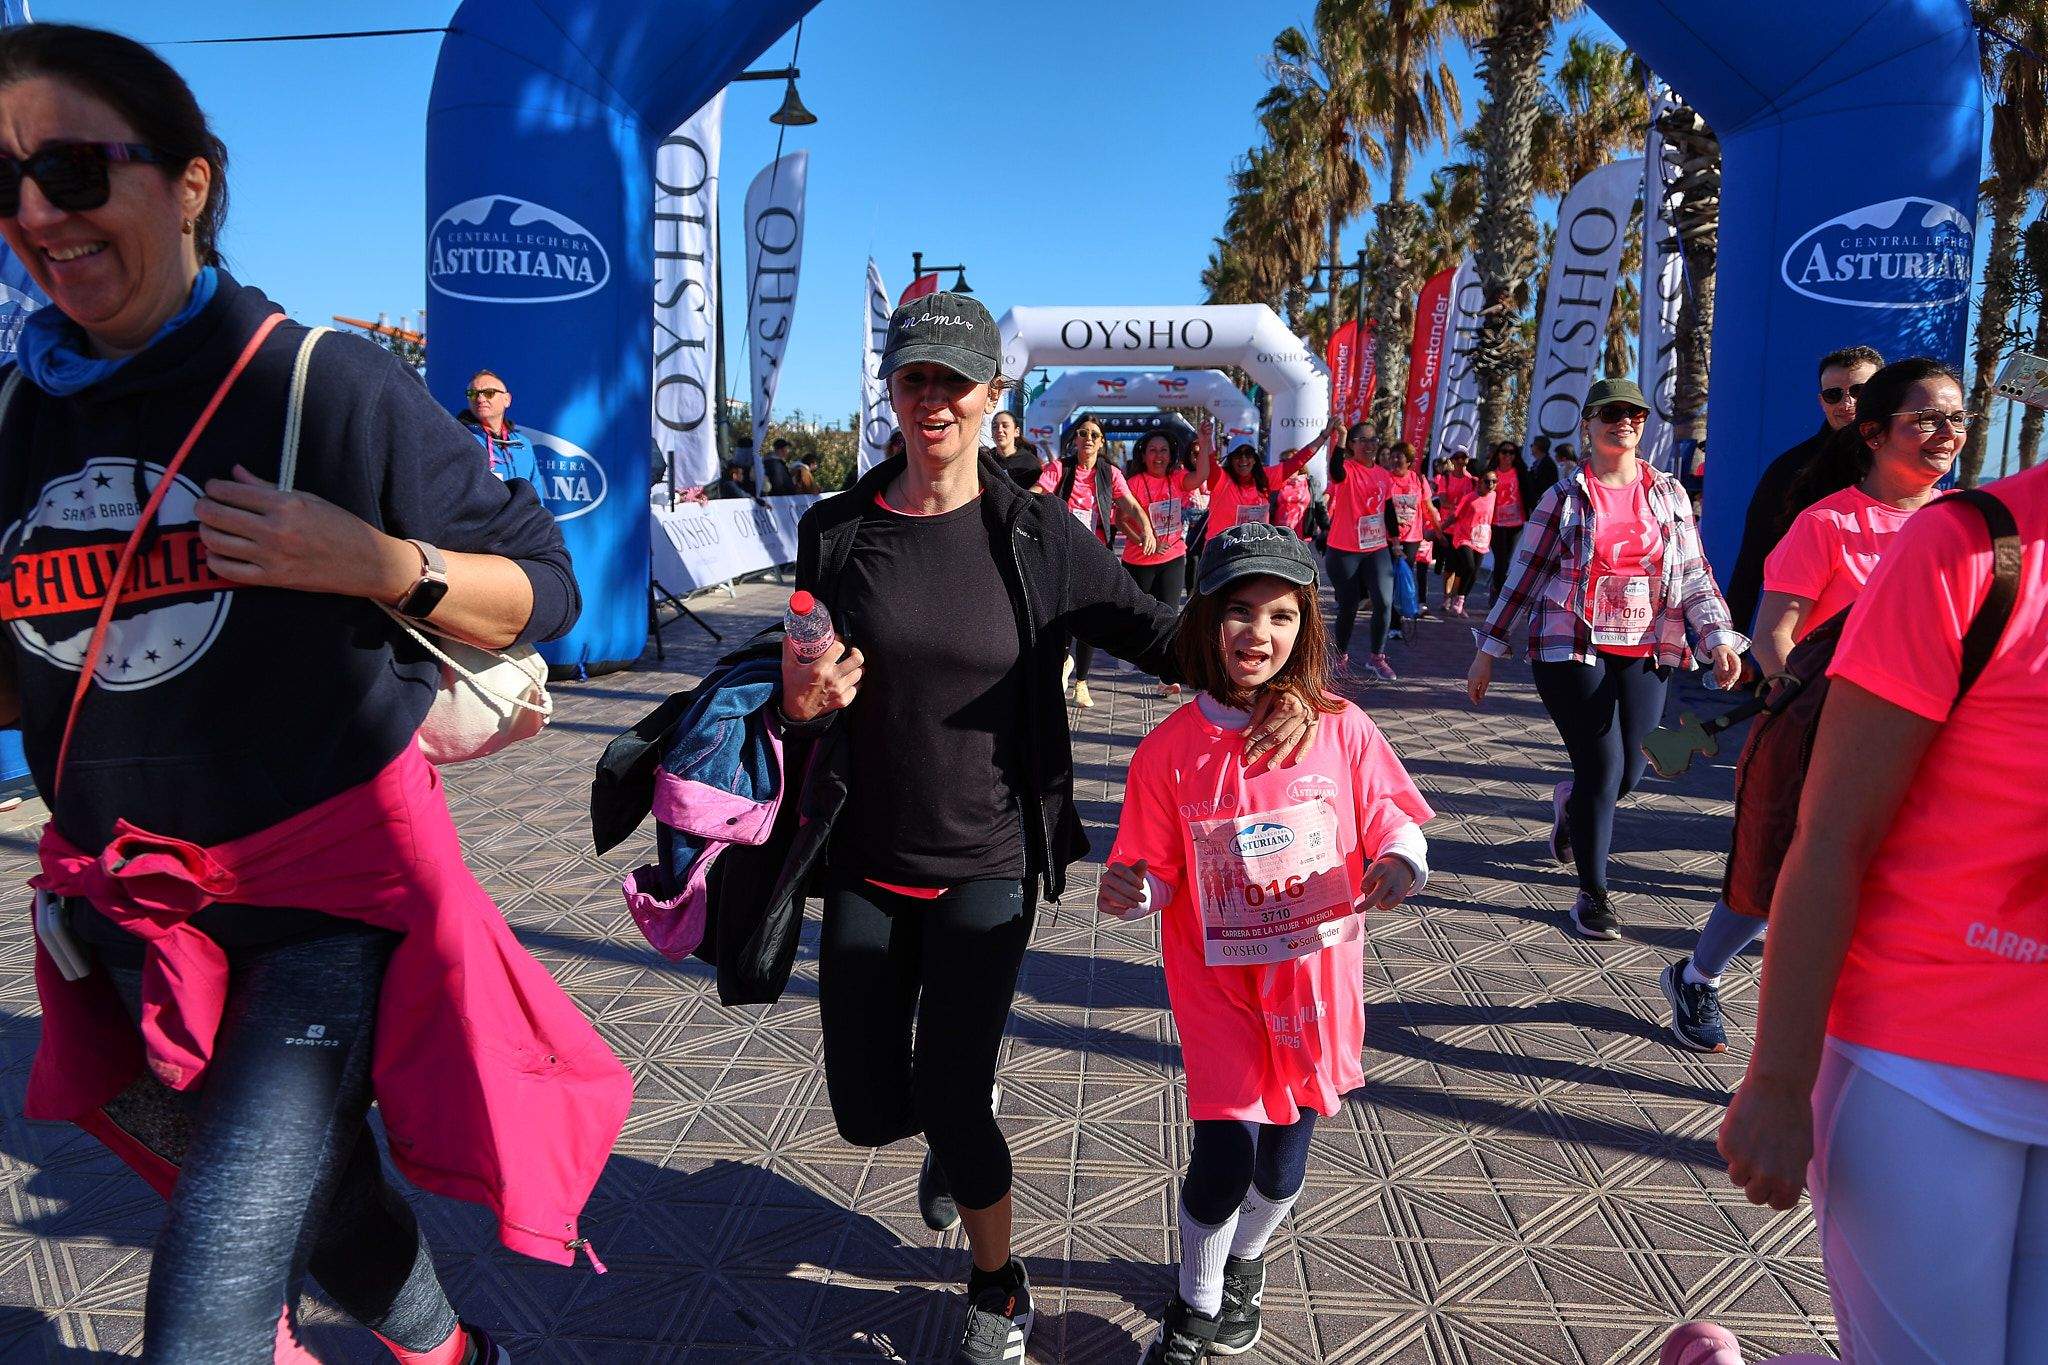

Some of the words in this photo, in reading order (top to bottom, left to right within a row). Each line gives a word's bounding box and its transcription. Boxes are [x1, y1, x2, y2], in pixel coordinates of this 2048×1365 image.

[448, 231, 508, 243] CENTRAL
[515, 233, 590, 251] LECHERA
[1840, 236, 1918, 248] CENTRAL
[432, 237, 596, 284] ASTURIANA
[1798, 242, 1970, 284] ASTURIAN
[655, 135, 707, 432] OYSHO
[902, 311, 965, 329] mama
[1540, 207, 1617, 438] OYSHO
[1061, 319, 1213, 350] OYSHO
[1421, 293, 1450, 388] Santander
[1257, 352, 1303, 363] OYSHO
[1335, 342, 1349, 410] Santander
[1281, 417, 1323, 428] OYSHO
[101, 502, 142, 518] BARBA
[662, 512, 720, 552] OYSHO
[733, 507, 778, 538] OYSHO
[1623, 608, 1645, 619] 016
[1180, 793, 1236, 819] OYSHO
[1234, 834, 1291, 853] ASTURIANA
[1244, 875, 1305, 908] 016
[1221, 927, 1250, 938] CARRERA
[1252, 927, 1262, 936] DE
[1264, 925, 1274, 935] LA
[1275, 921, 1300, 934] MUJER
[1305, 909, 1335, 925] VALENCIA
[1261, 908, 1291, 924] 3710
[1300, 927, 1341, 947] Santander
[1222, 944, 1268, 957] OYSHO
[285, 1037, 340, 1047] DOMYOS
